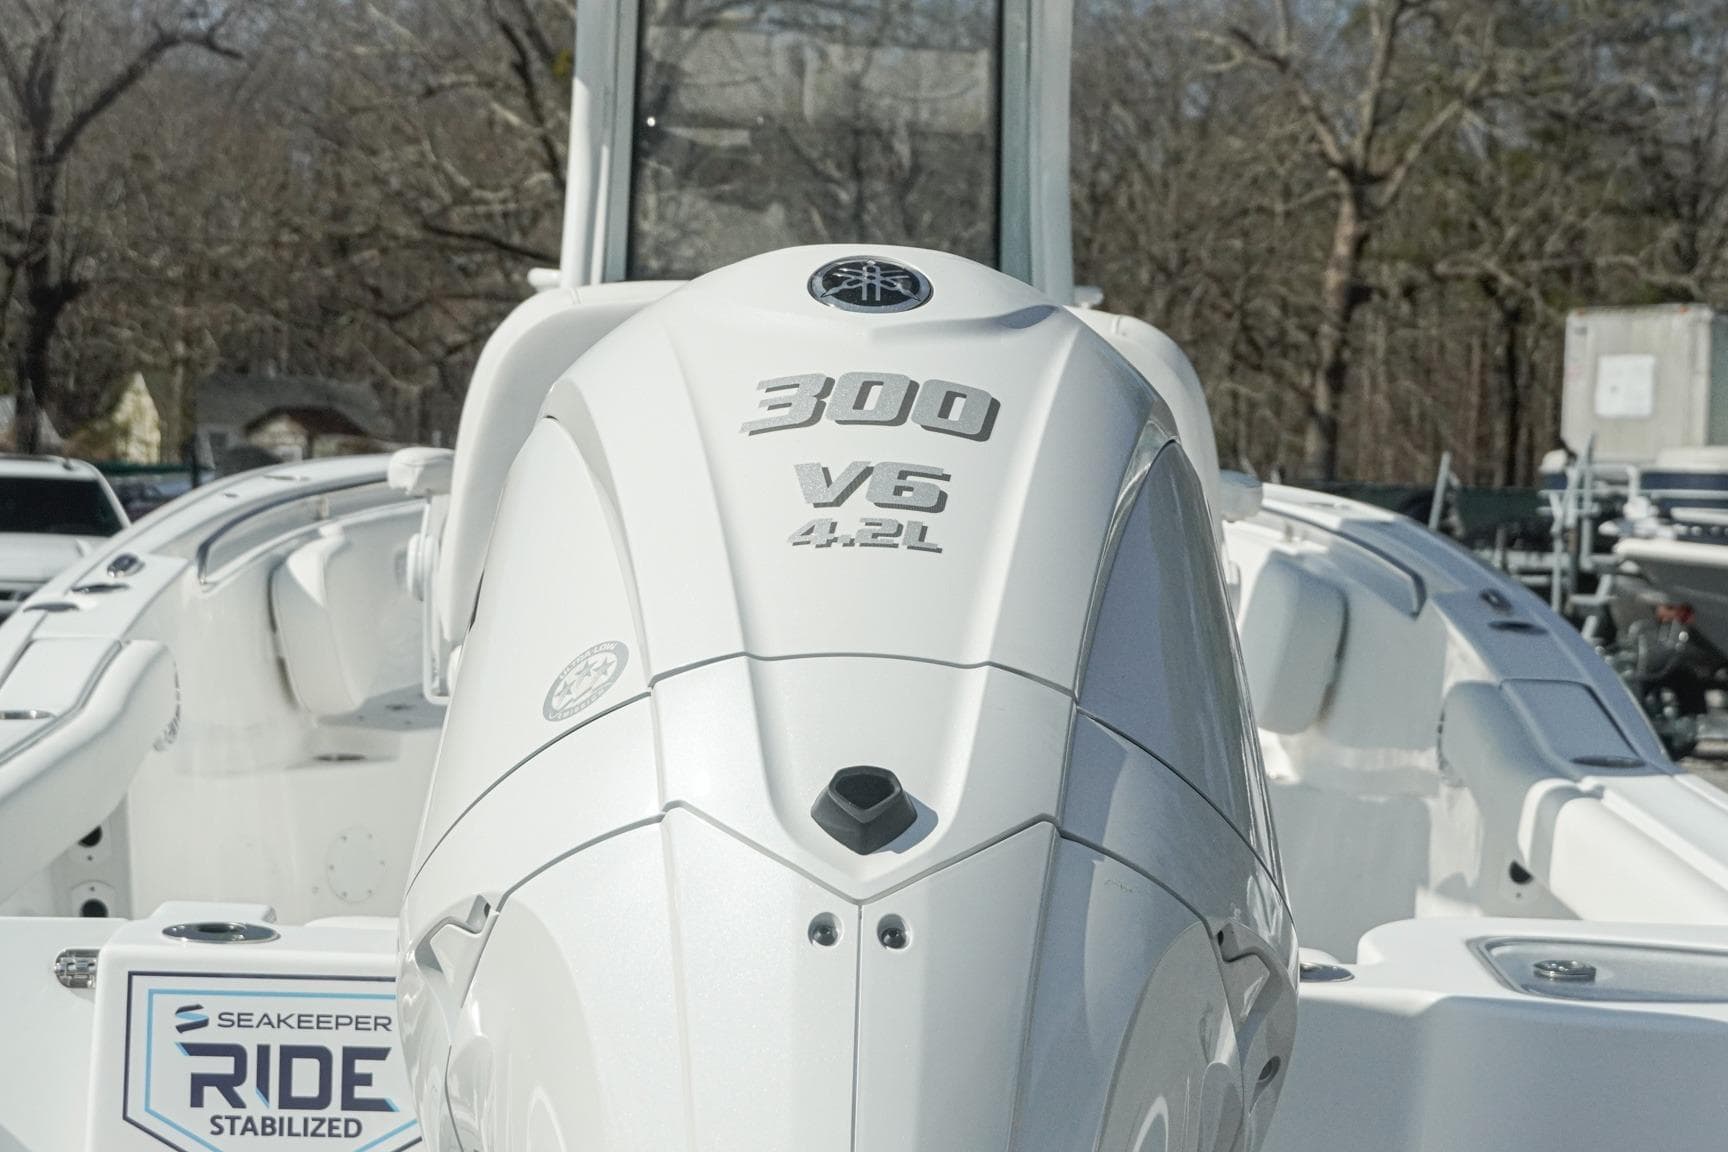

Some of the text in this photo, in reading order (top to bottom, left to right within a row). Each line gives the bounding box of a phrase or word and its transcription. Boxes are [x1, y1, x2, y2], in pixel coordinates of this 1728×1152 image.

[738, 371, 1001, 442] 300
[793, 461, 952, 513] V6
[787, 517, 943, 553] 4.2L
[217, 1011, 393, 1032] SEAKEEPER
[174, 1041, 400, 1113] RIDE
[209, 1114, 363, 1139] STABILIZED
